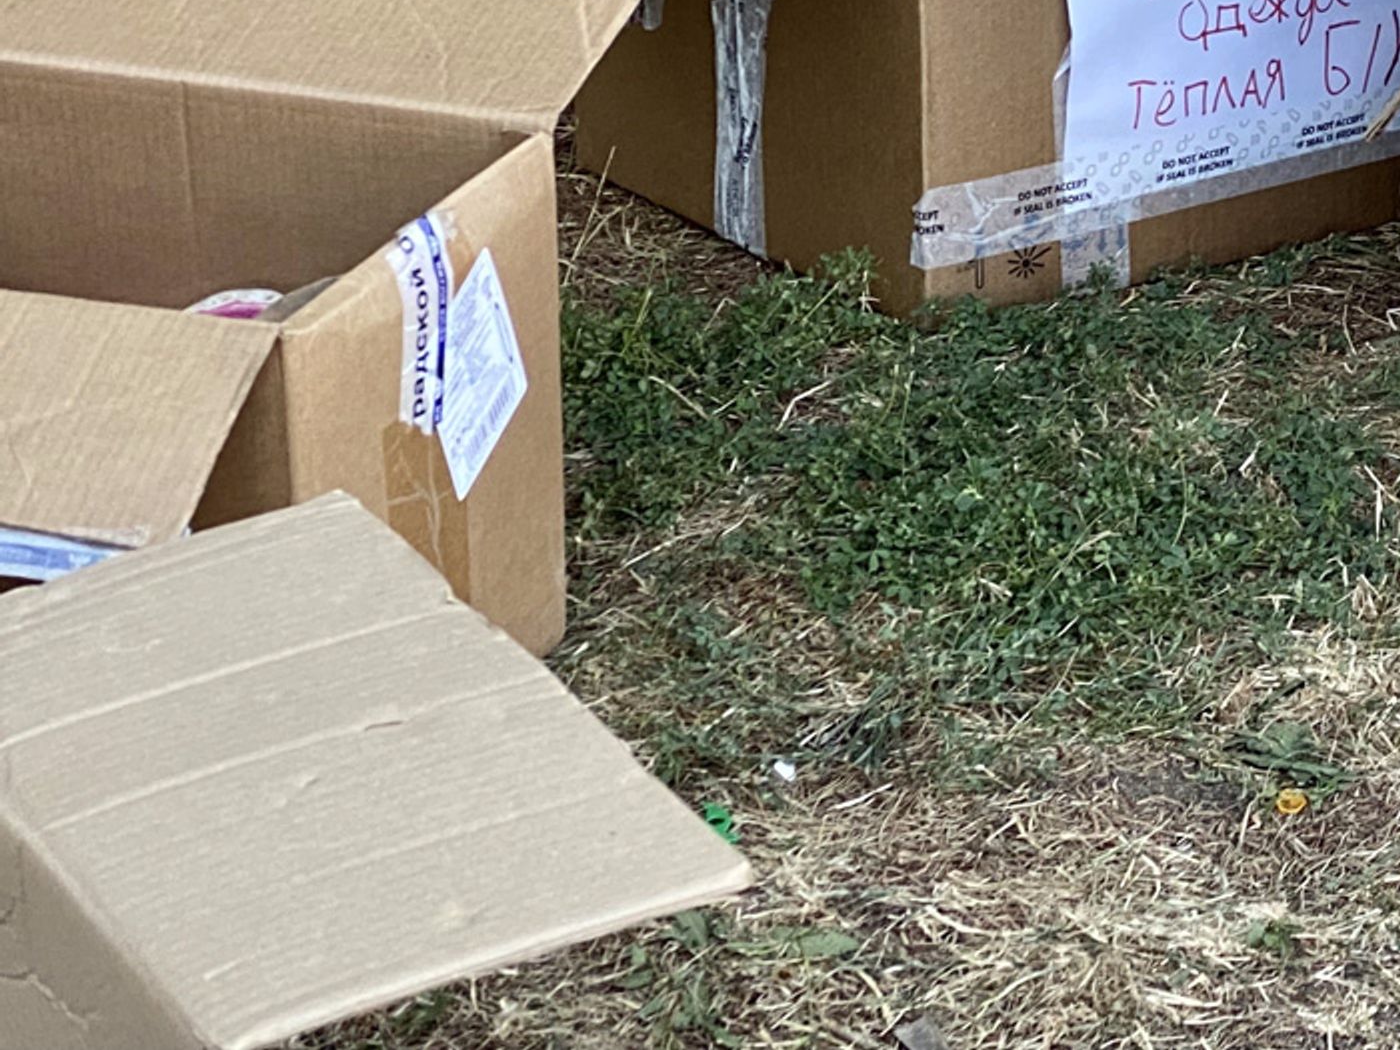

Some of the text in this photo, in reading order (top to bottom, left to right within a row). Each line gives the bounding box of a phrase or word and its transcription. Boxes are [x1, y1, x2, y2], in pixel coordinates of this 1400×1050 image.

[1302, 113, 1366, 136] DO NOT ACCEPT
[1306, 136, 1324, 147] SEAL
[1335, 126, 1368, 139] BROKEN
[1162, 146, 1231, 170] DO NOT ACCEPT
[1156, 159, 1234, 183] IF SEAL IS BROKEN
[1018, 177, 1088, 202] DO NOT ACCEPT
[1023, 202, 1043, 214] SEAL
[1056, 192, 1092, 207] BROKEN
[411, 267, 429, 419] радской
